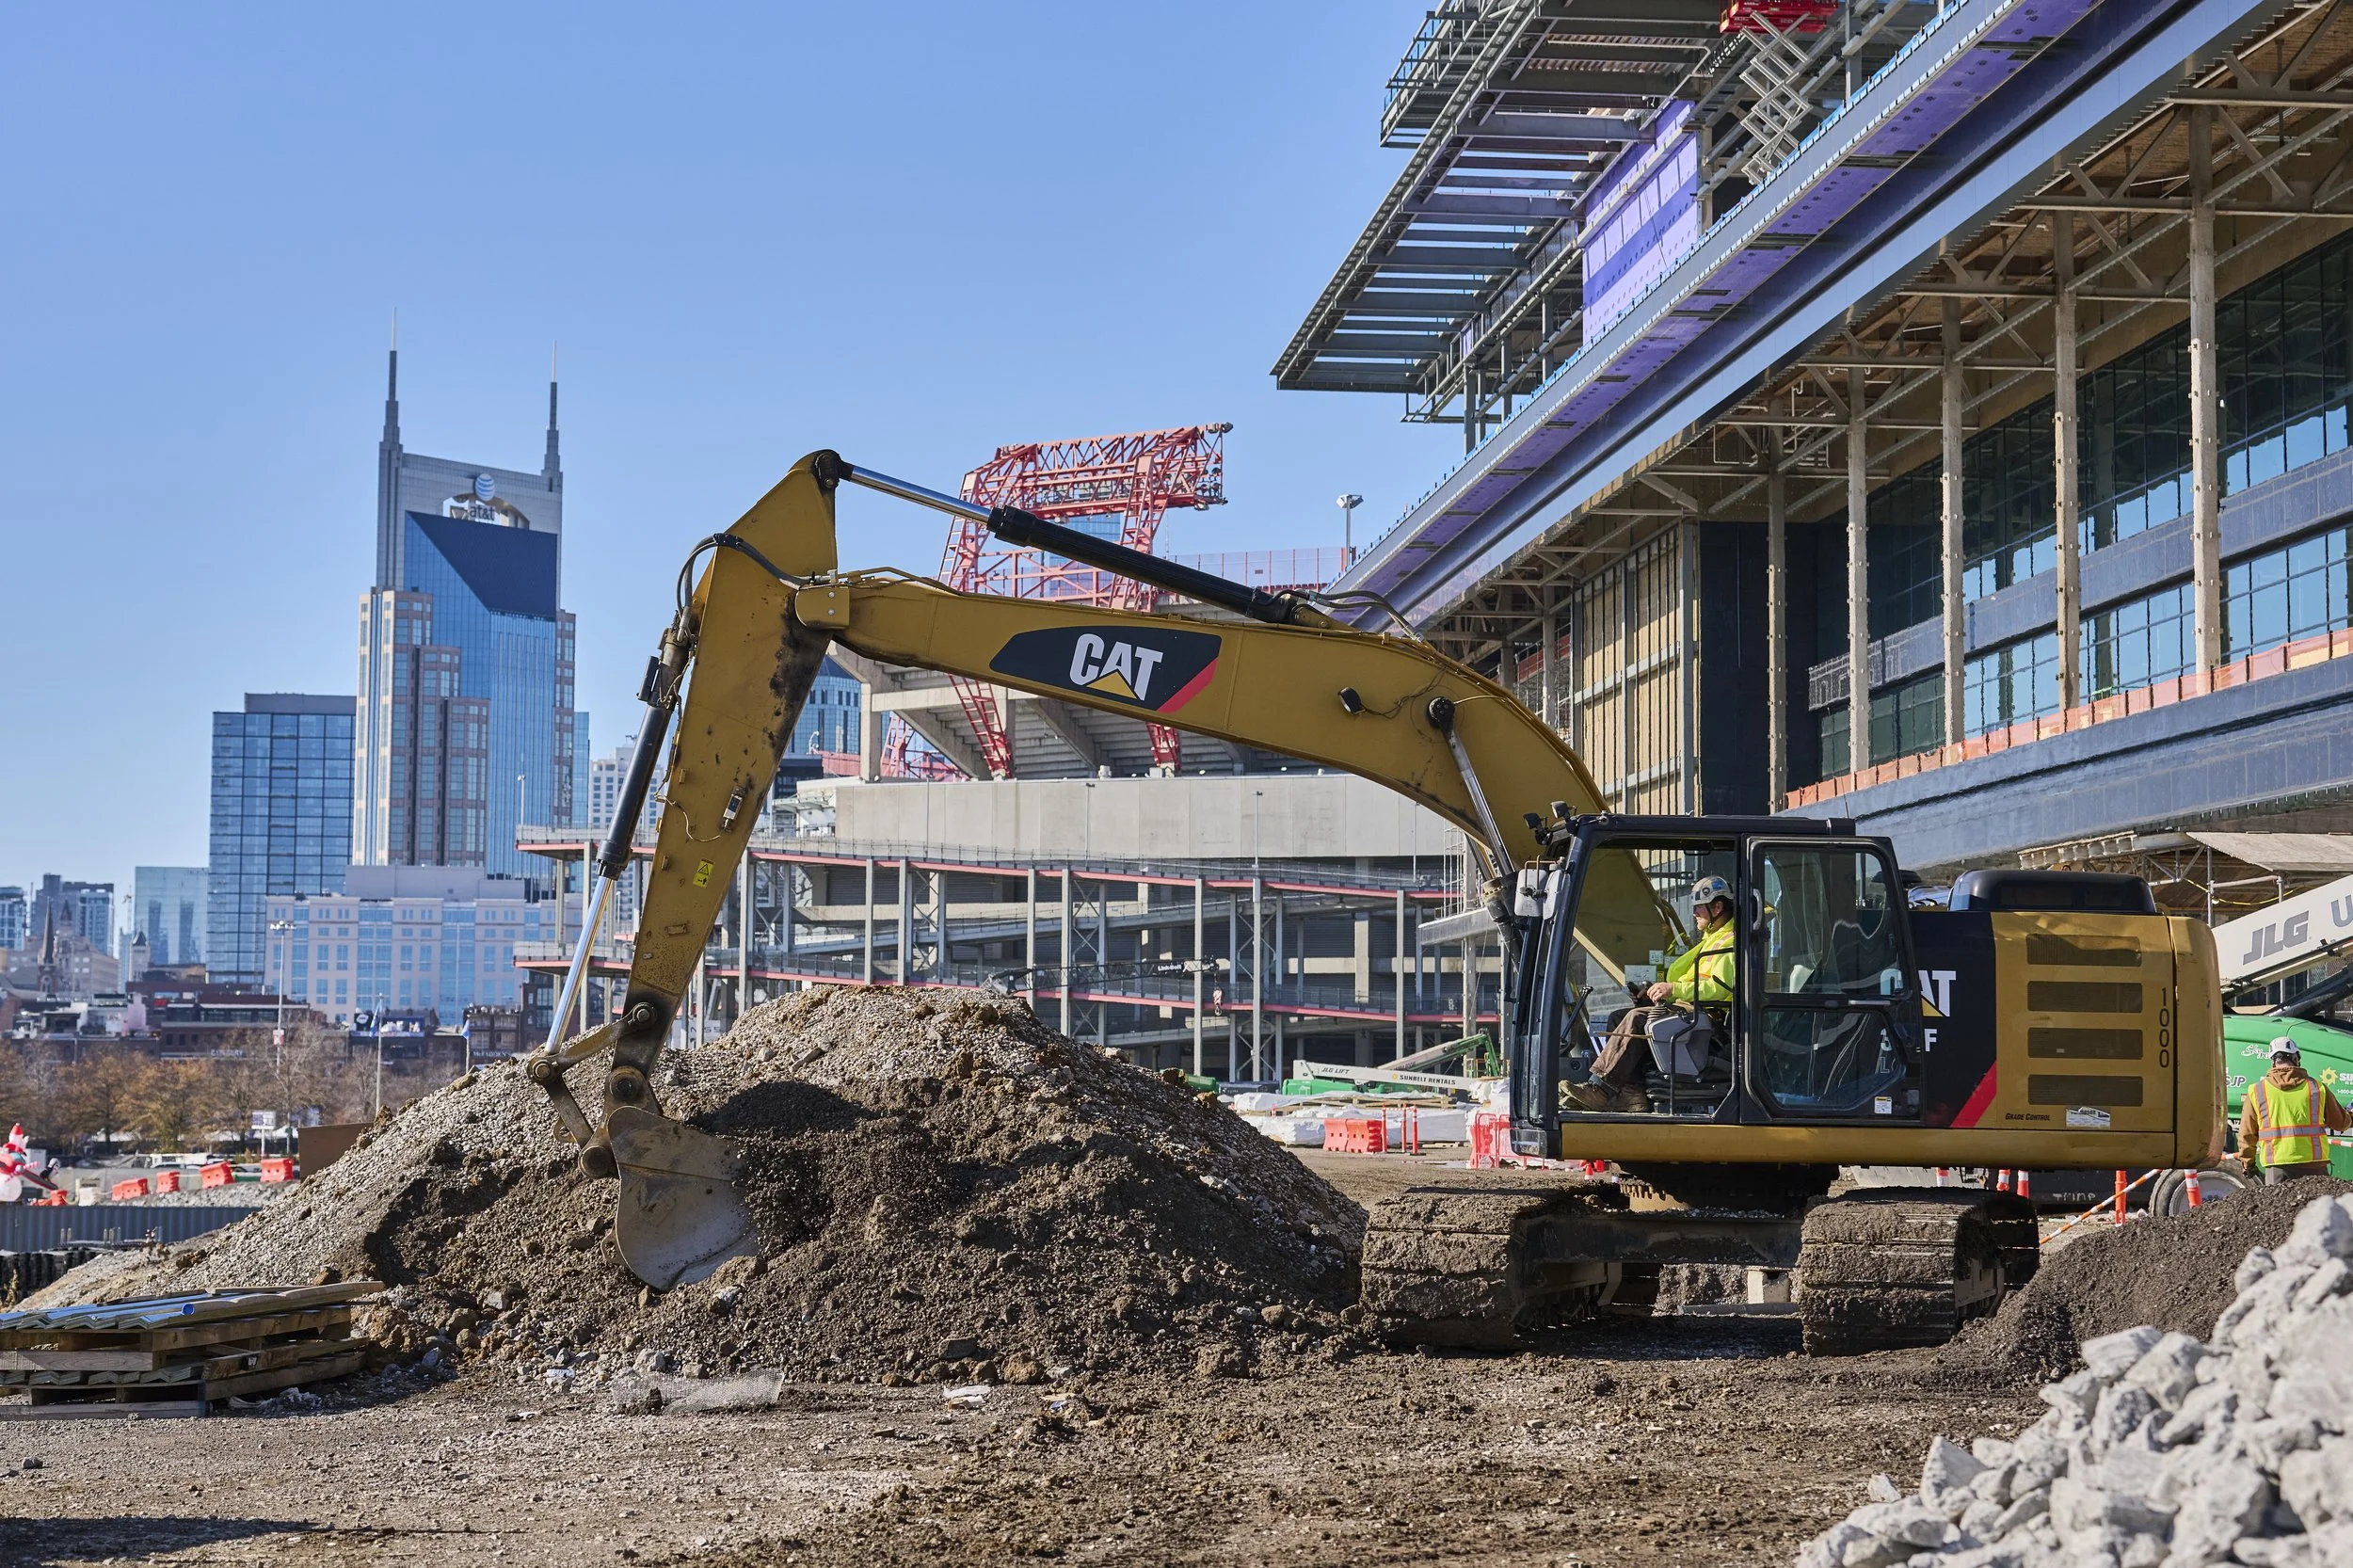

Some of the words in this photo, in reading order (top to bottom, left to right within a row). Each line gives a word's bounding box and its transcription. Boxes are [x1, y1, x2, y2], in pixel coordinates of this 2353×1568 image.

[470, 505, 494, 520] at&t
[1069, 632, 1163, 701] CAT
[2243, 910, 2310, 966] JLG
[1400, 1074, 1427, 1082] SUNBELT
